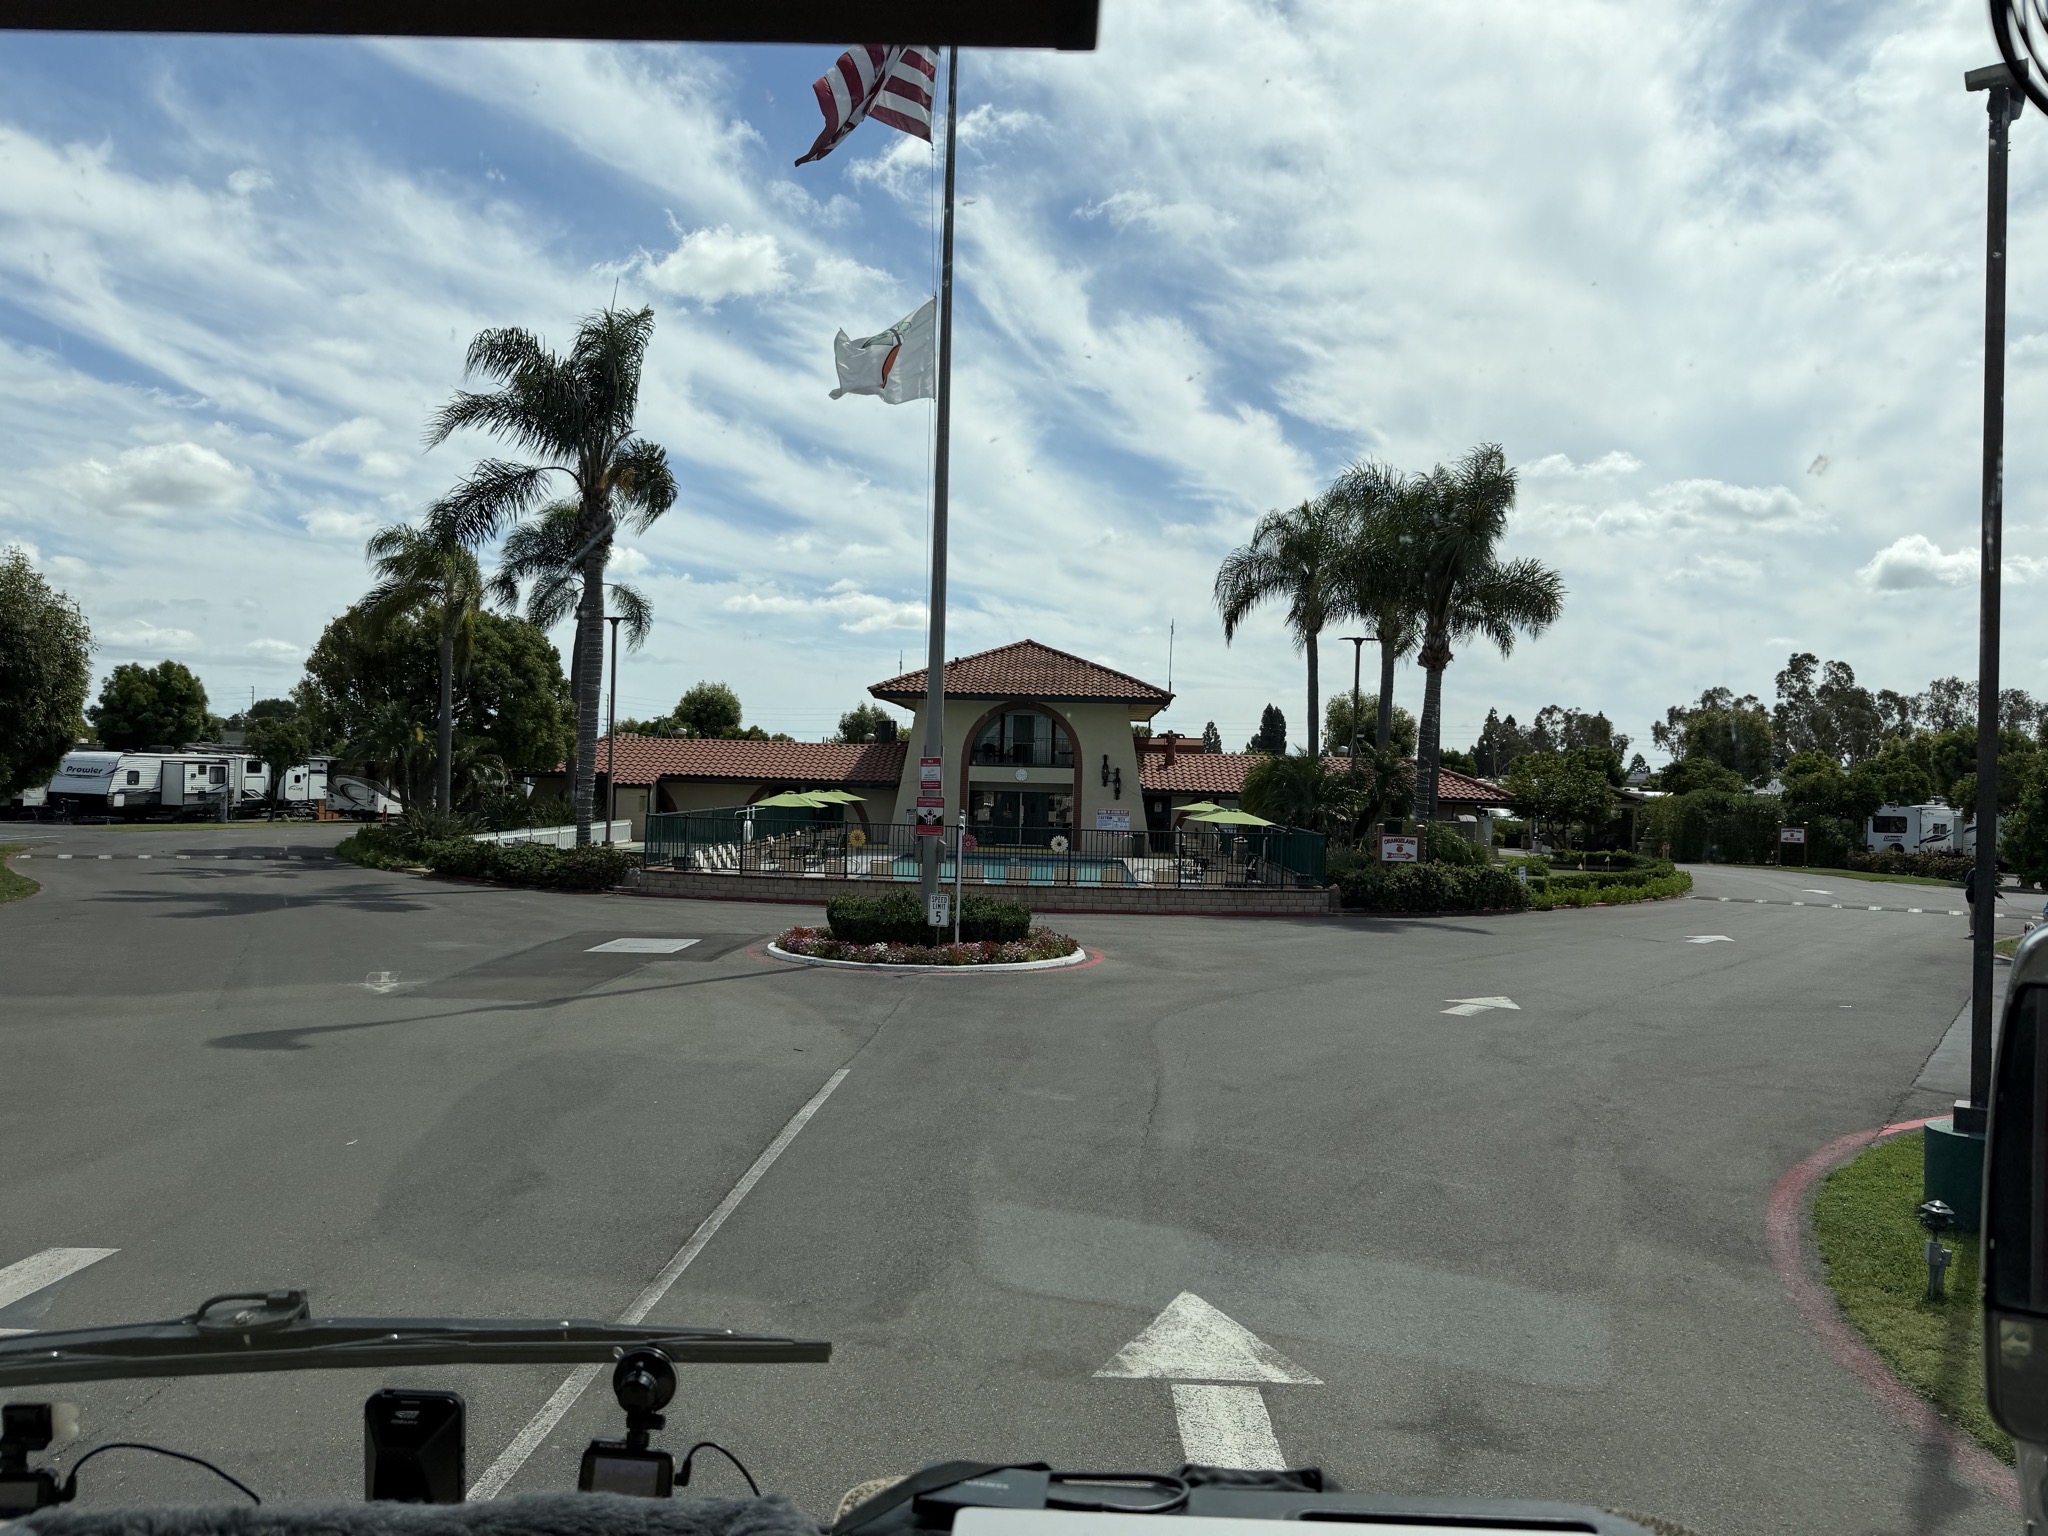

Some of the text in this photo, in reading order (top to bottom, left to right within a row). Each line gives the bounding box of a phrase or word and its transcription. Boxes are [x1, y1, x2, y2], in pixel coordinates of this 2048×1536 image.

[66, 765, 104, 775] Prowler
[931, 895, 948, 904] SPEED
[935, 911, 942, 924] 5
